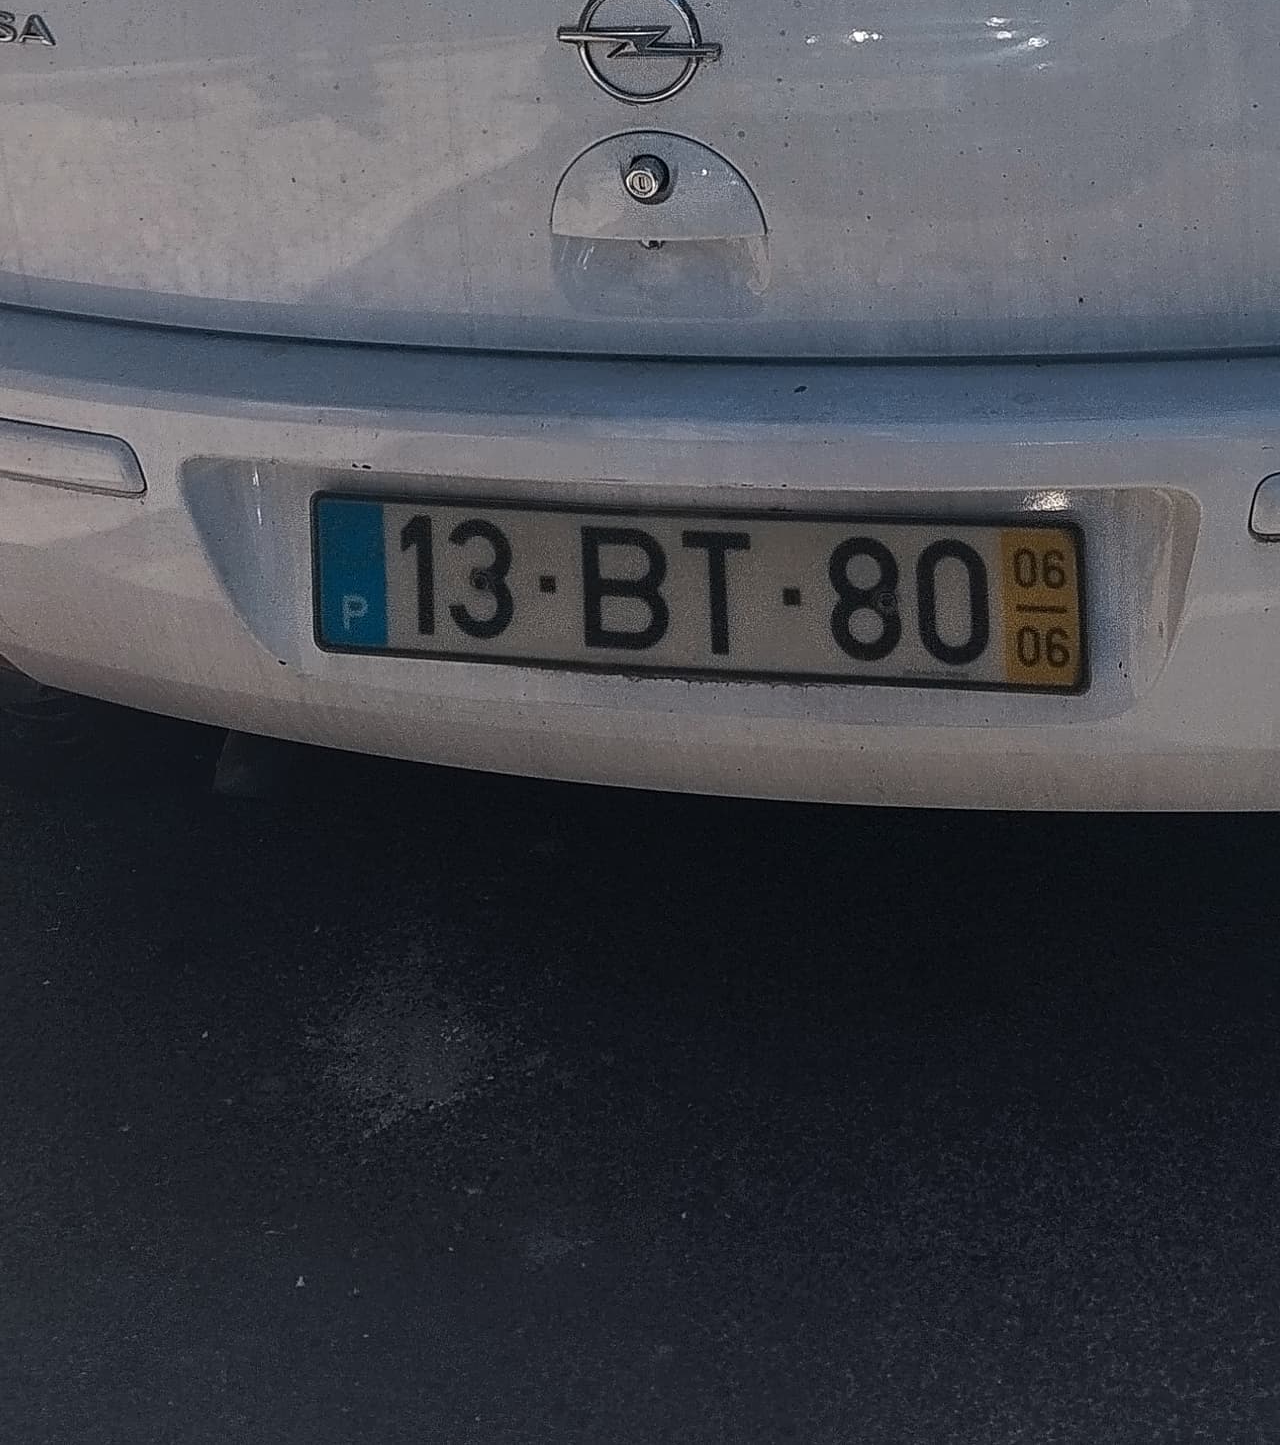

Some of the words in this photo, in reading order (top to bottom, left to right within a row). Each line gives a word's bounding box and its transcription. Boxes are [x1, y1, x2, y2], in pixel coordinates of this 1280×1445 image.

[1013, 547, 1066, 590] 06
[342, 594, 369, 630] P
[1017, 625, 1071, 669] 06
